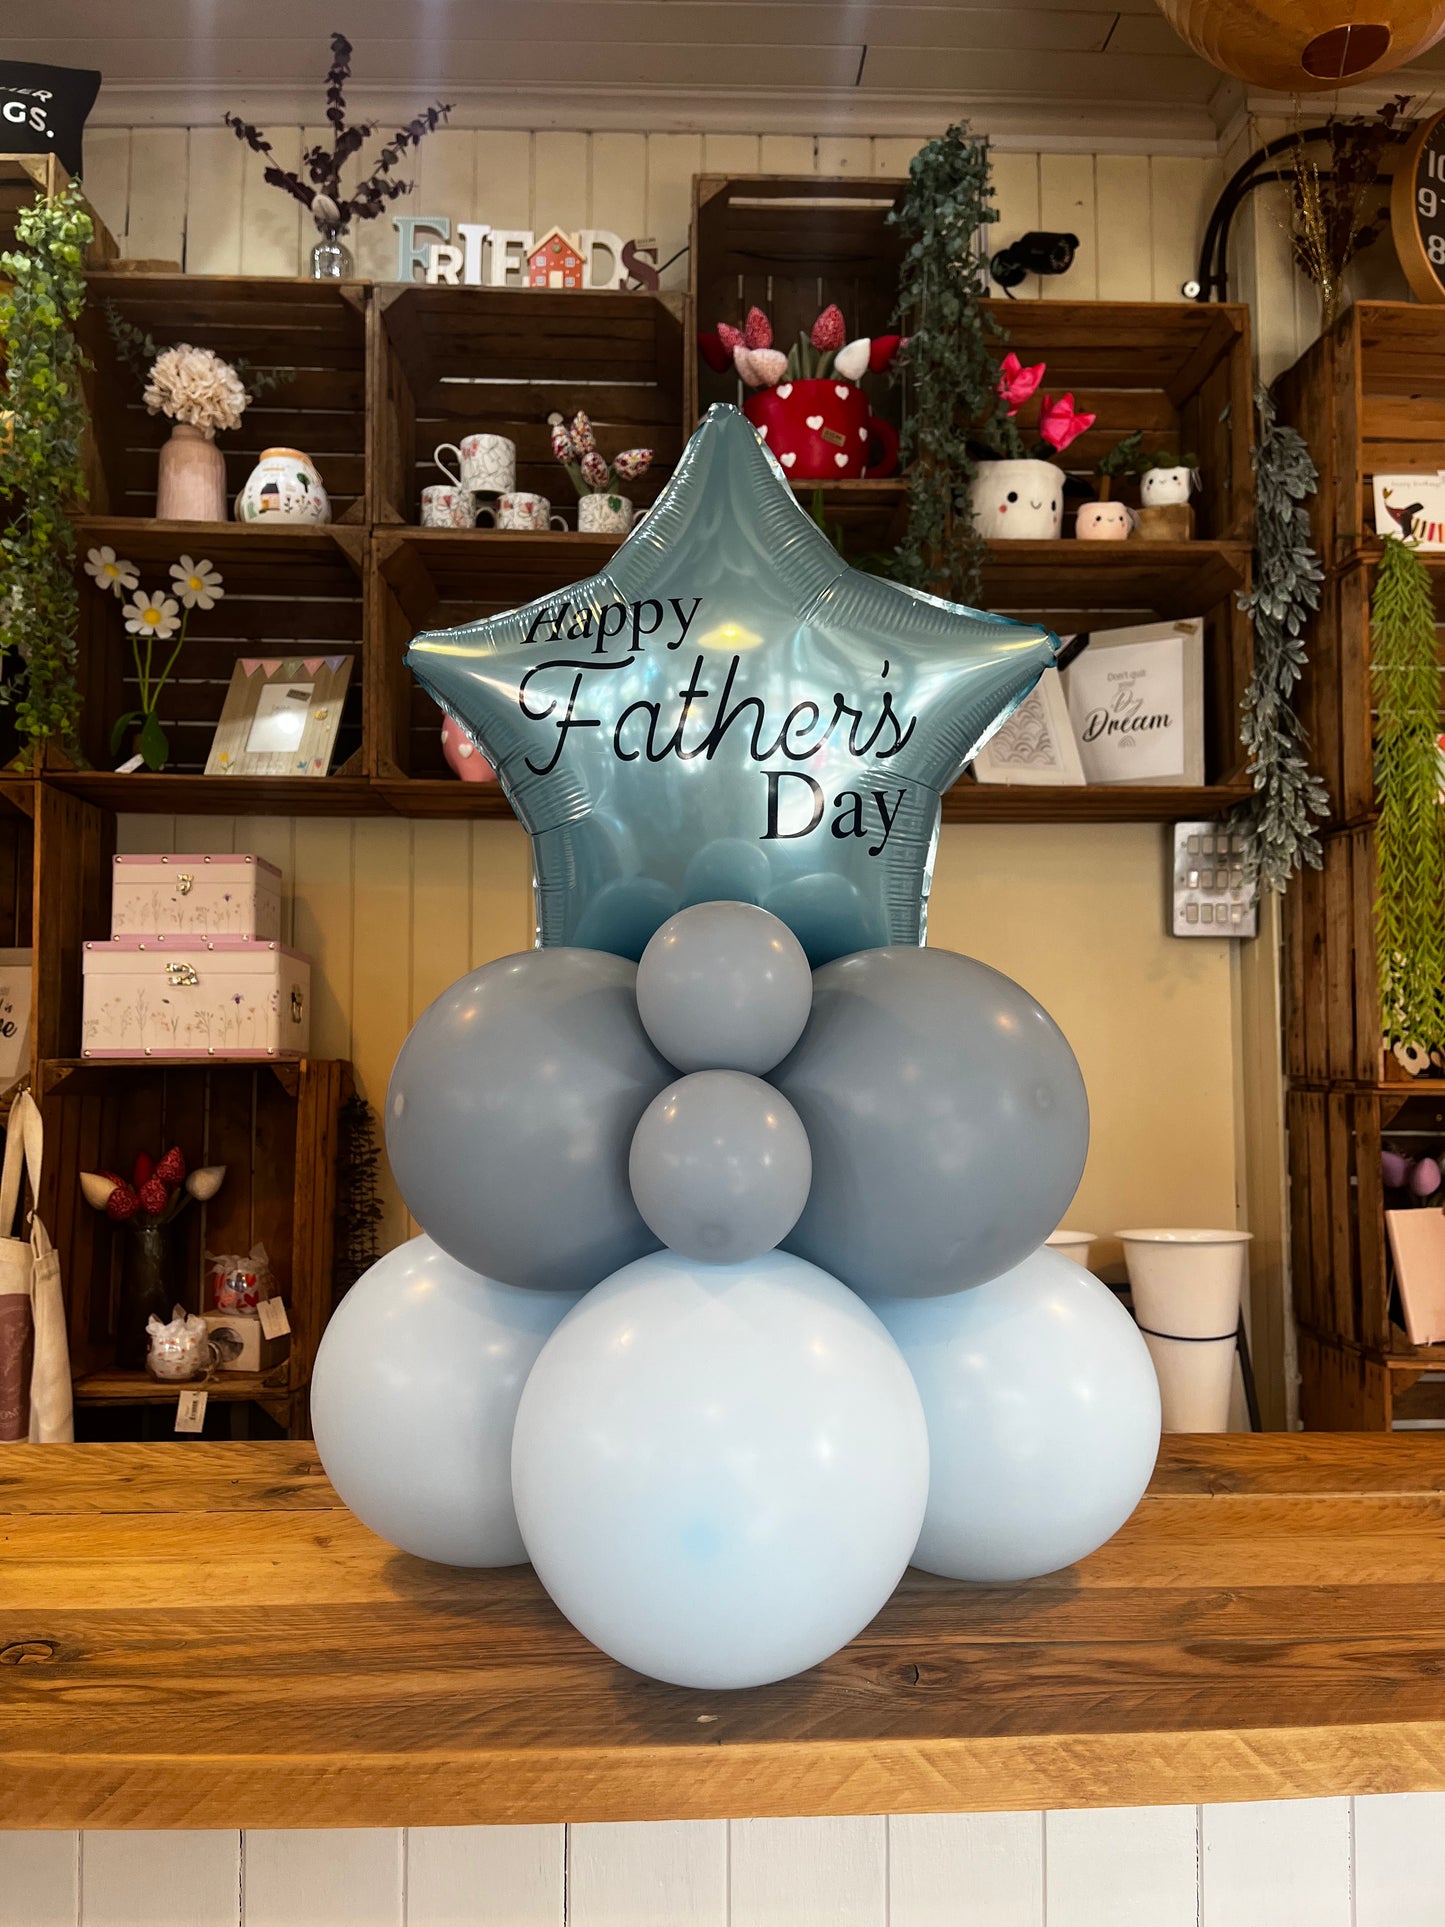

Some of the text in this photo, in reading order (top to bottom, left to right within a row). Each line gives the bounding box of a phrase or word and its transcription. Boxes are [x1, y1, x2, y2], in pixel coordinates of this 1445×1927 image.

[3, 101, 54, 138] GS.
[1418, 187, 1437, 218] 9
[392, 216, 660, 291] FRIEDS
[1427, 234, 1445, 265] 8
[520, 597, 703, 654] Happy
[519, 654, 917, 776] Father's
[1082, 707, 1173, 742] Dream
[759, 770, 907, 856] Day
